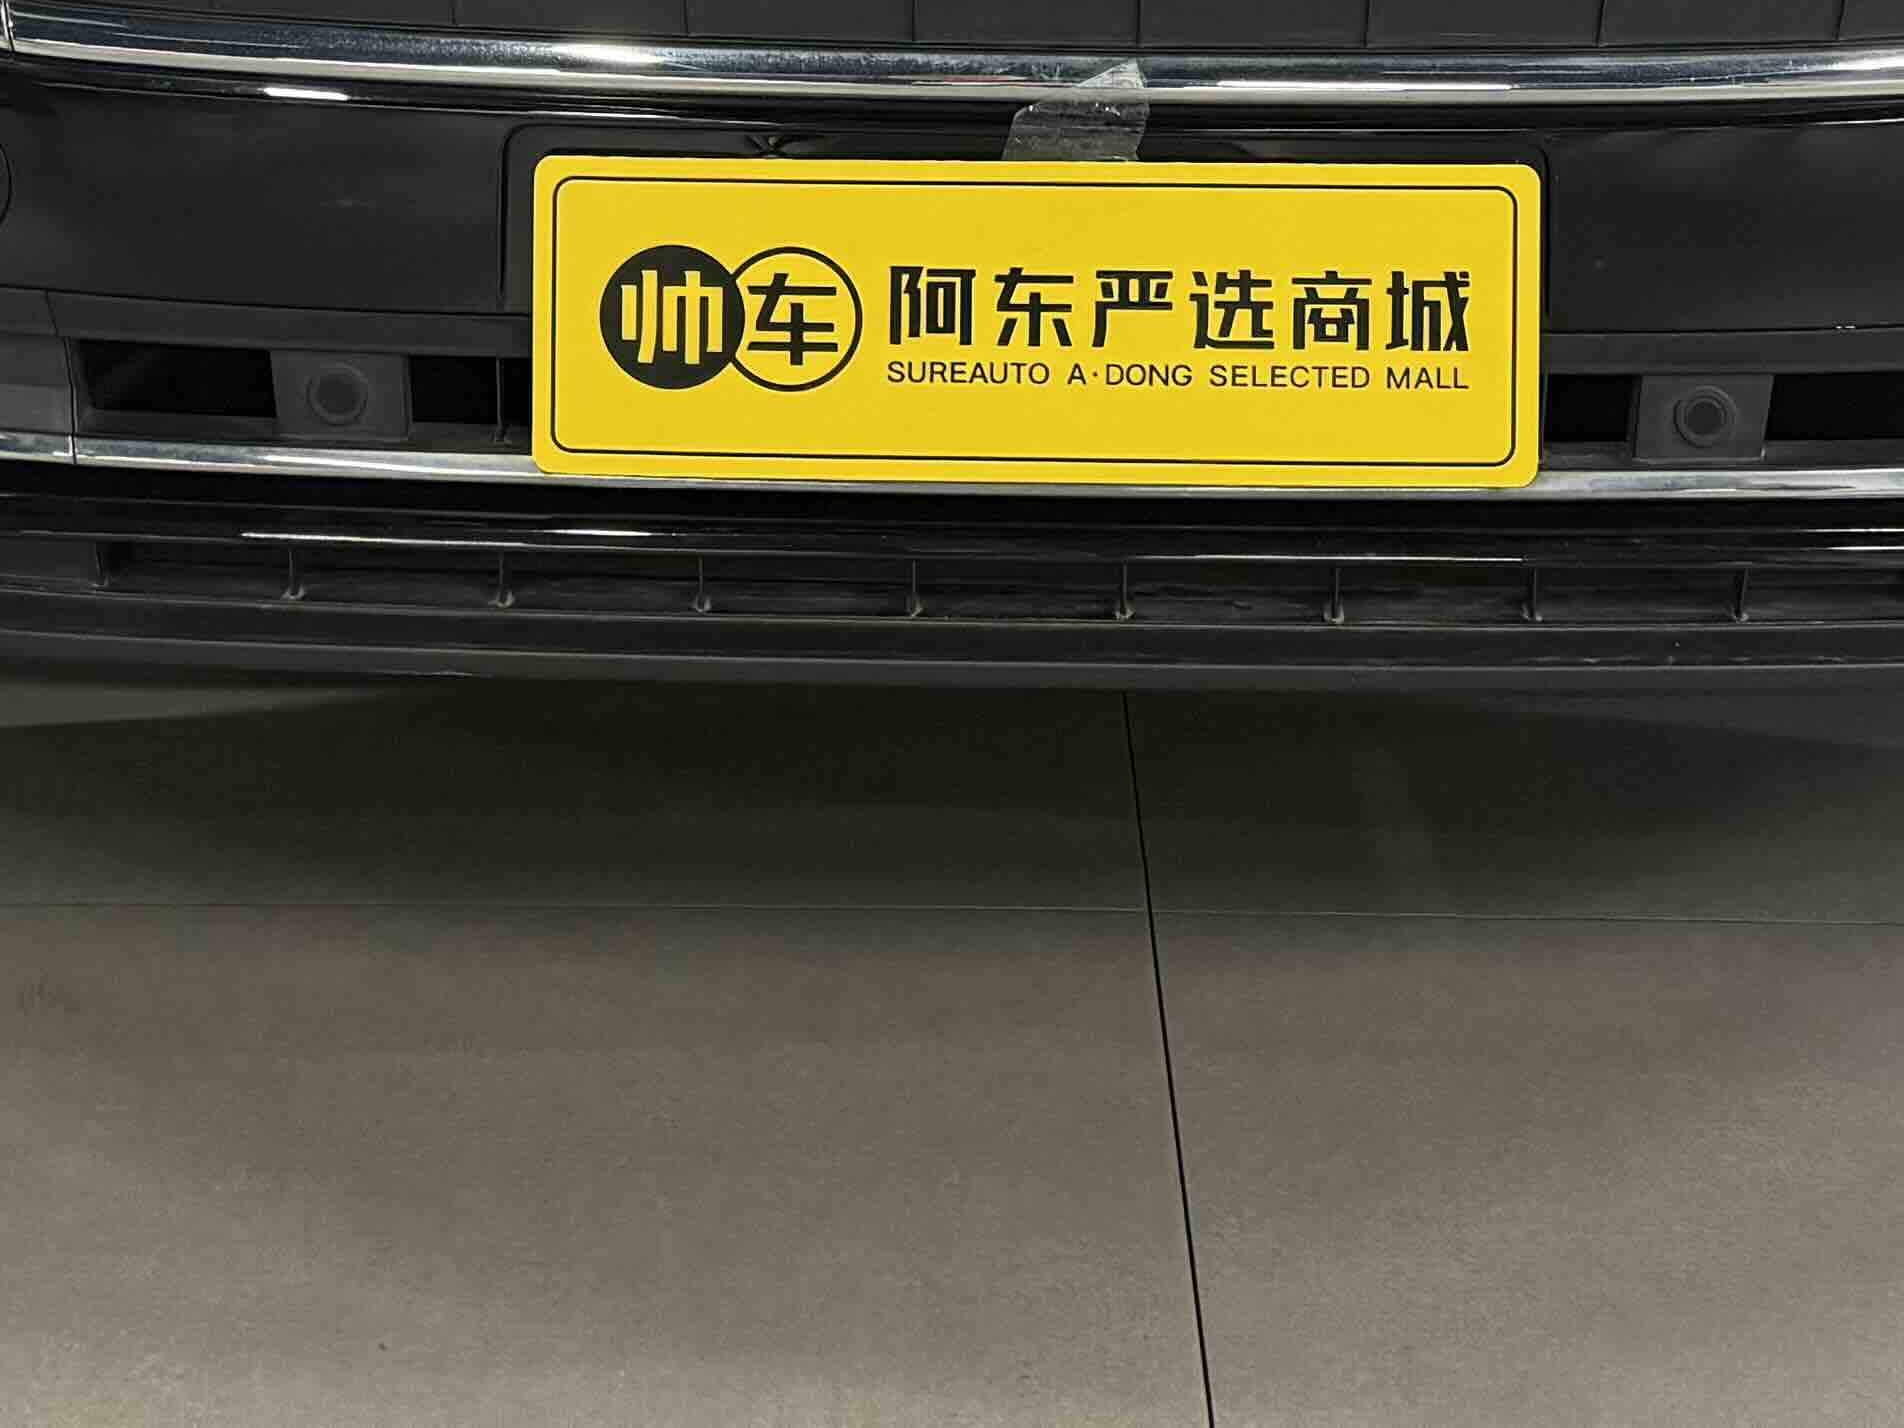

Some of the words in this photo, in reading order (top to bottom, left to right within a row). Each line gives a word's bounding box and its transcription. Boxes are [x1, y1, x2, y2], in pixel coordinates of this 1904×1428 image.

[615, 265, 844, 371] 帅车
[889, 266, 1471, 352] 阿东严选商城
[887, 361, 1050, 385] SUREAUTO
[1067, 363, 1193, 387] A·DONG
[1209, 365, 1371, 390] SELECTED
[1386, 367, 1470, 390] MALL
